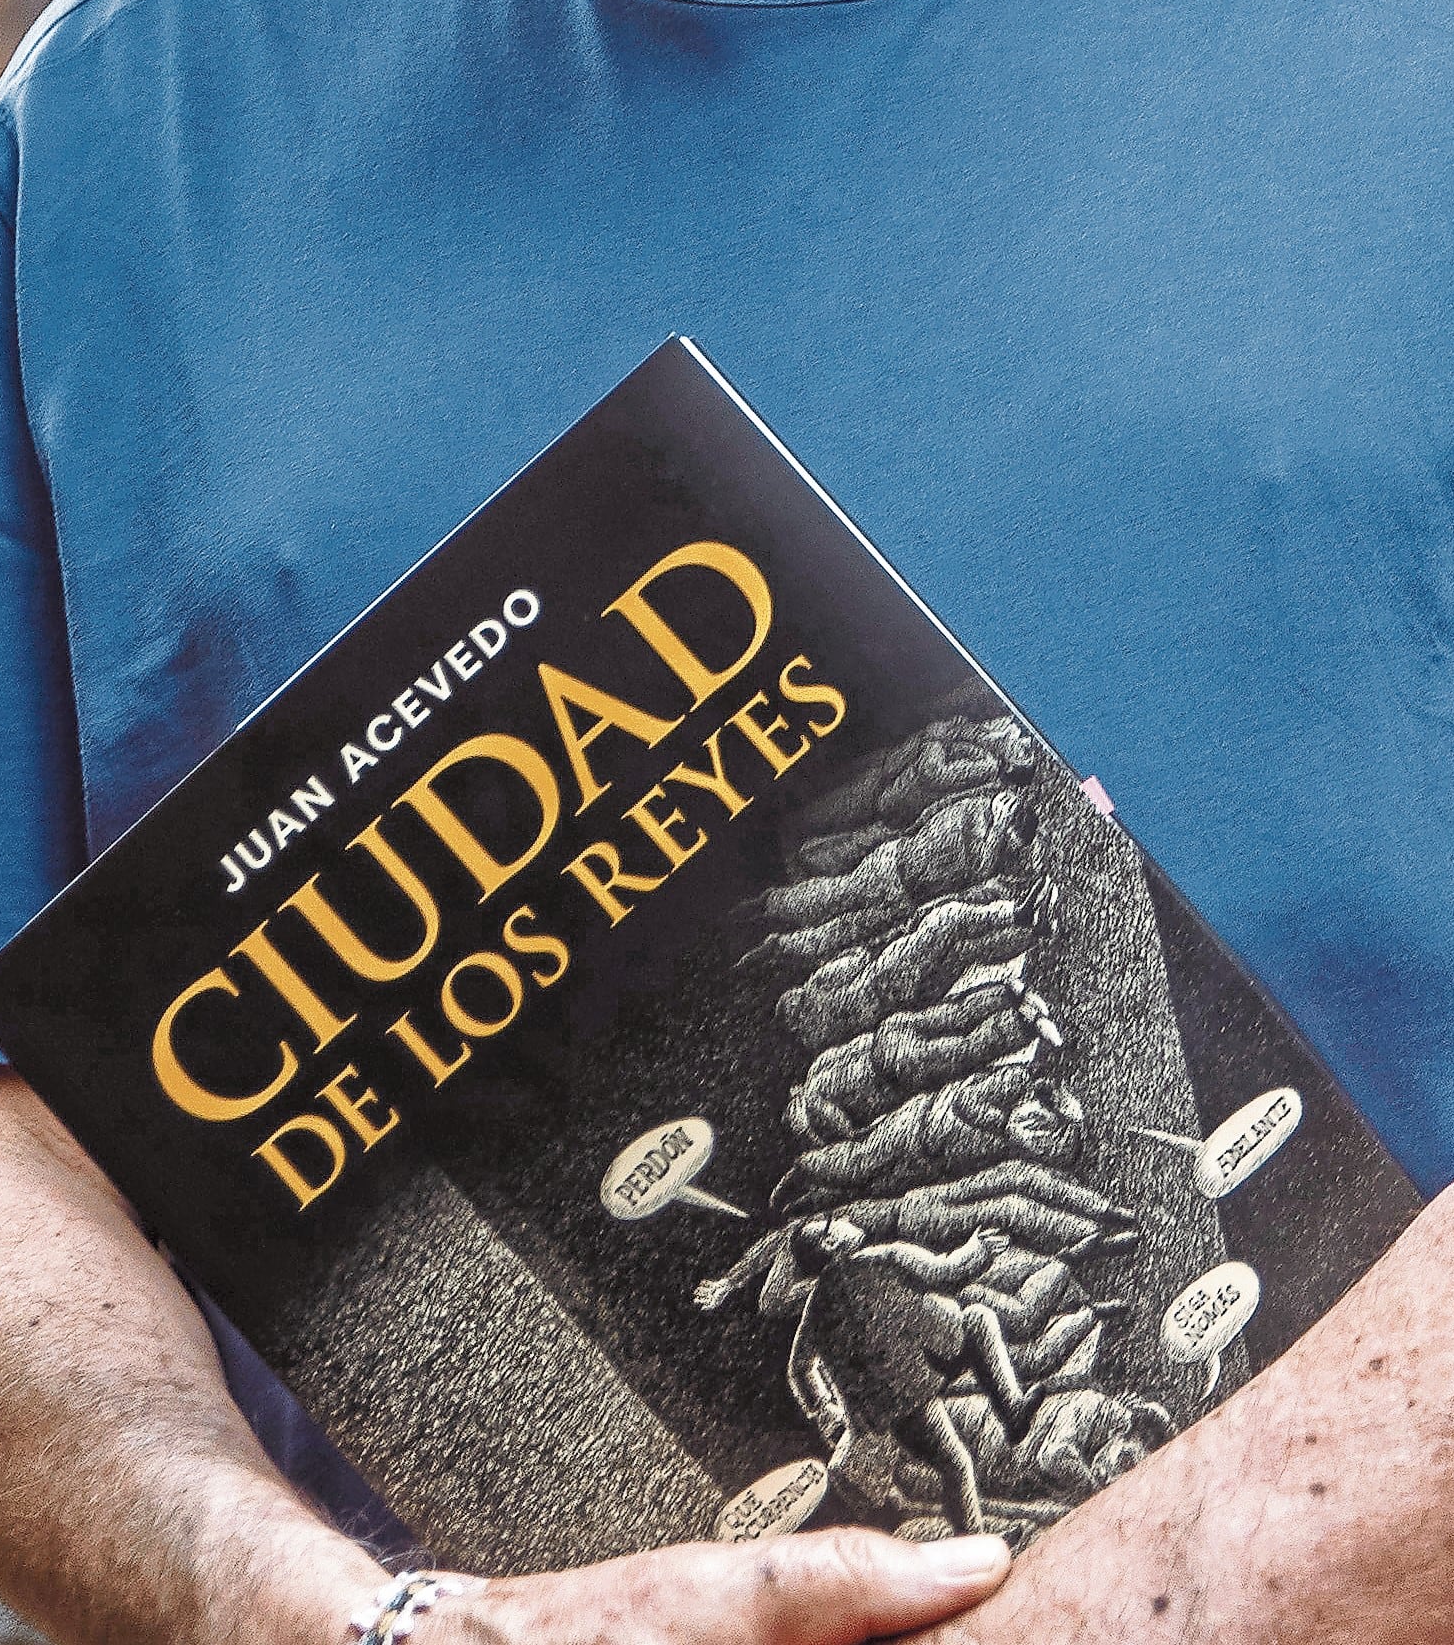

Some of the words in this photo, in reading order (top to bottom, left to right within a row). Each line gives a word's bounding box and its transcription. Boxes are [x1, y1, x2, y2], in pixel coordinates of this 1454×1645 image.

[151, 540, 775, 1123] CIUDAD
[220, 774, 337, 893] JUAN
[340, 588, 541, 785] ACEVEDO
[251, 1063, 402, 1213] DE
[385, 906, 573, 1089] LOS
[561, 654, 849, 929] REYES
[614, 1126, 694, 1206] PERDÓN
